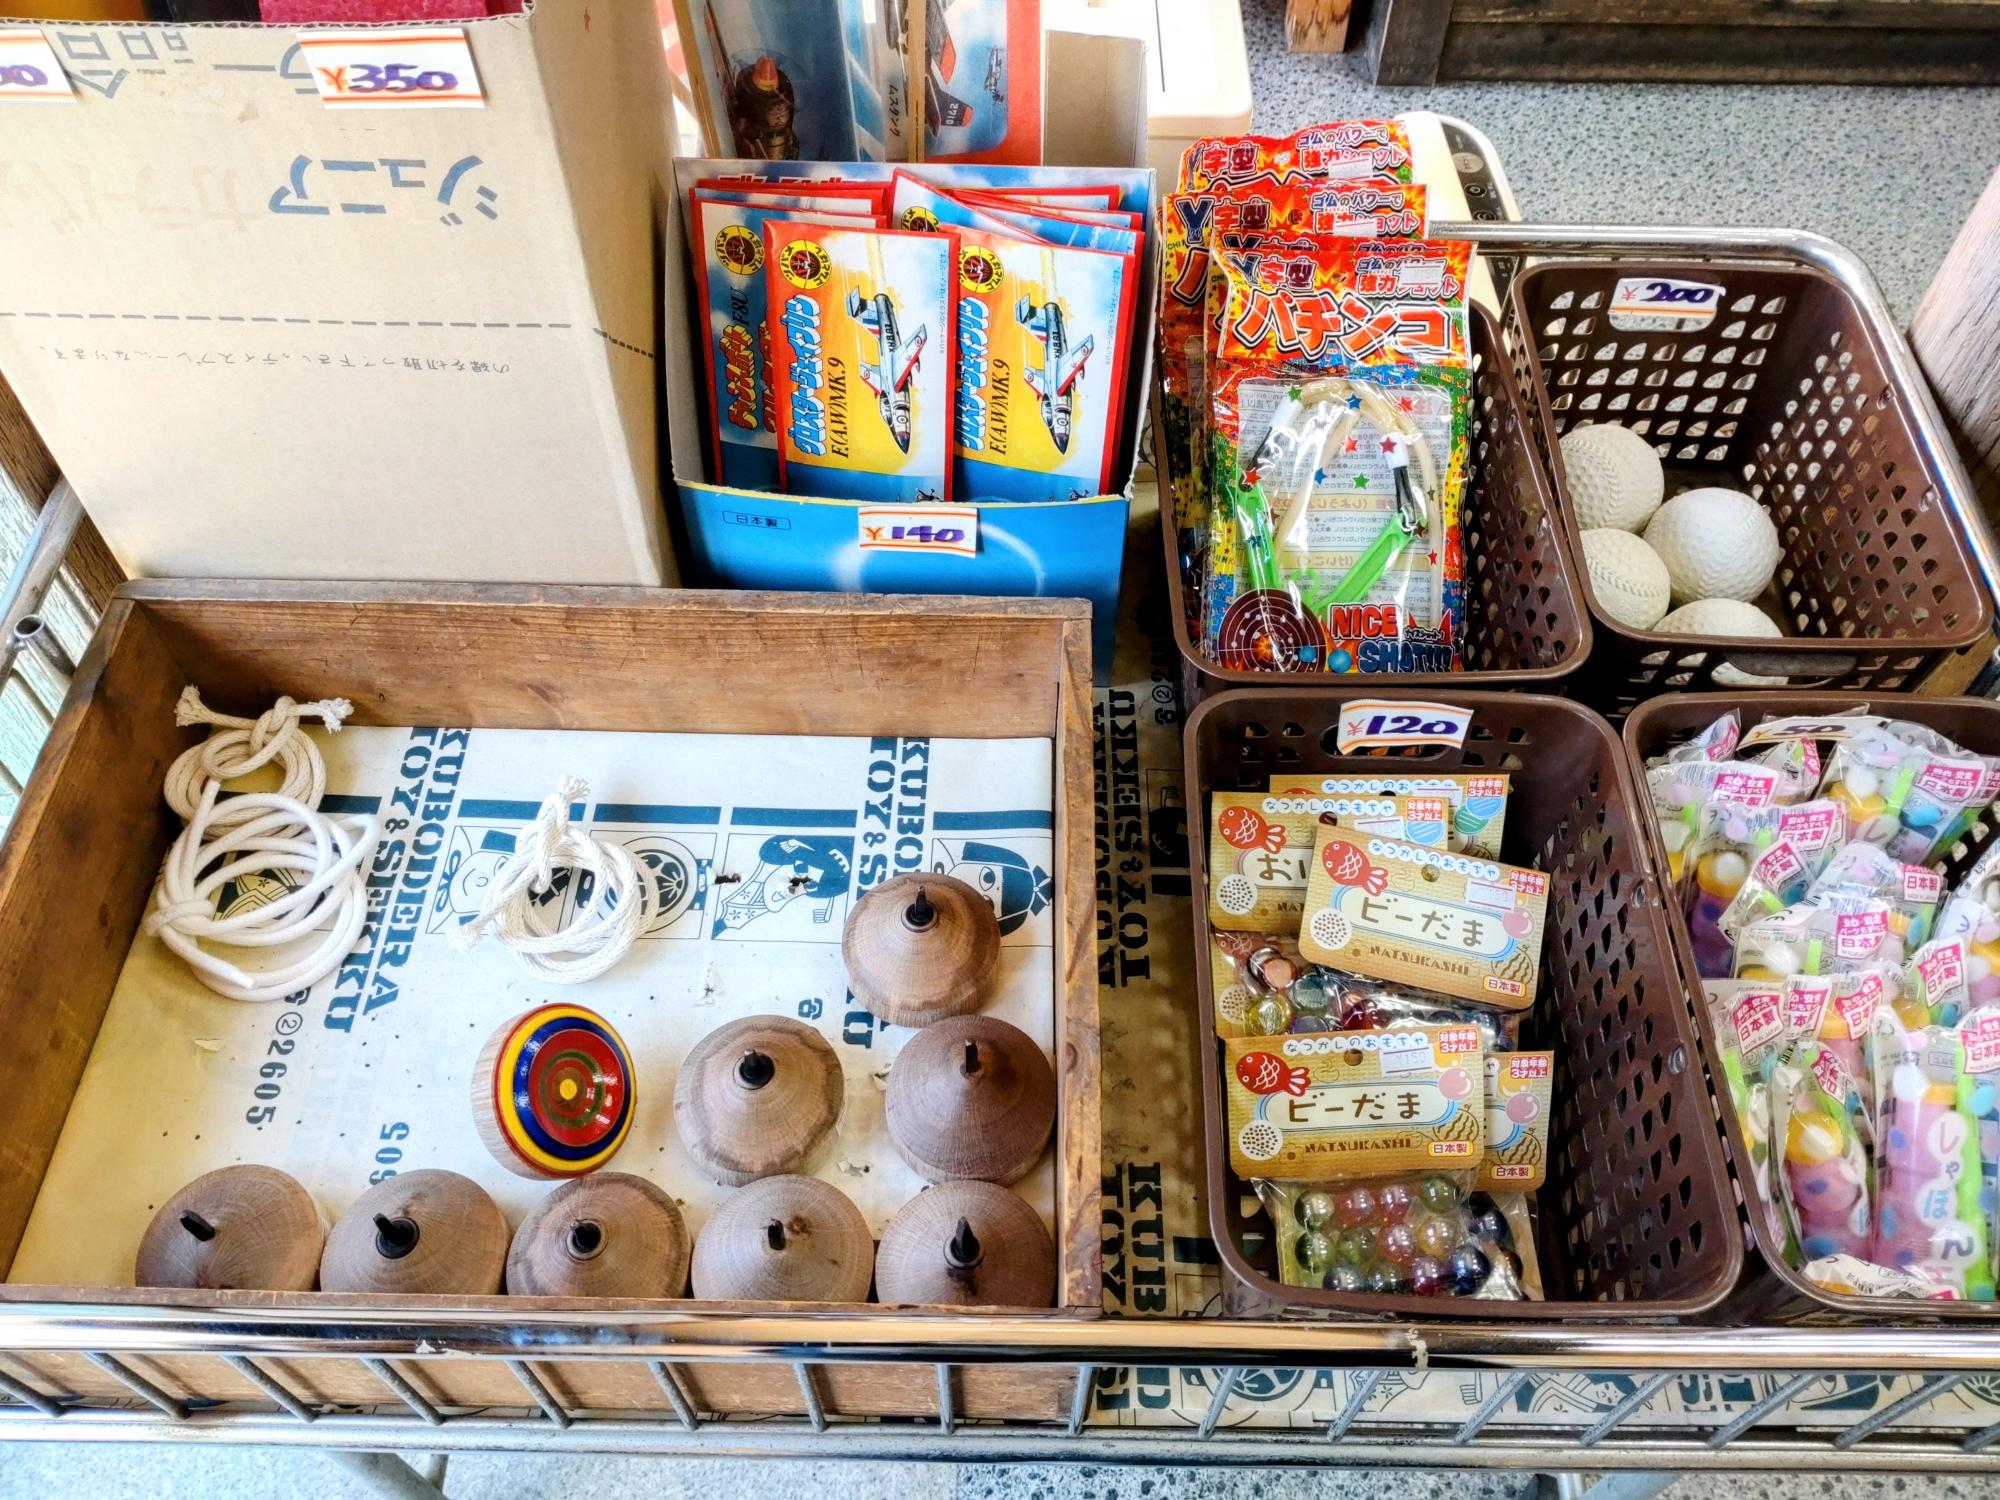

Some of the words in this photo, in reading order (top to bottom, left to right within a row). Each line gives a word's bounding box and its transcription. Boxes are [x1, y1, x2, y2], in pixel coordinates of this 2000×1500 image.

[318, 64, 458, 94] ¥350
[946, 102, 959, 126] 2710
[1299, 127, 1387, 145] ゴムのパワーで
[268, 154, 498, 227] ジュニア
[1312, 191, 1402, 208] ゴムのパワーで
[1176, 198, 1270, 243] Y字型
[1225, 254, 1315, 289] Y字型
[1621, 282, 1715, 304] ¥200
[729, 286, 751, 326] F8U
[1240, 289, 1449, 356] パチンコ
[736, 514, 778, 528] 日本製
[865, 525, 965, 543] ¥140
[1330, 606, 1400, 638] NICE
[1347, 715, 1459, 737] ¥120
[1467, 788, 1502, 797] 3才以上
[1468, 779, 1504, 789] 対象年齢
[893, 737, 931, 874] KUBO
[1265, 799, 1394, 814] なつかしのおもちゃ
[1407, 800, 1442, 811] 対象年齢
[1407, 812, 1442, 821] 3才以上
[1257, 853, 1306, 881] お
[1370, 842, 1499, 877] なつかしのおもちゃ
[363, 728, 472, 1016] KUBODERA
[1509, 871, 1545, 885] 対象年齢
[1907, 875, 1938, 891] 日本製
[1360, 896, 1485, 947] ビーだま
[1370, 945, 1470, 977] NATSUKASHI
[1487, 978, 1521, 994] 日本製
[1740, 1010, 1775, 1041] 日本製
[1286, 1036, 1425, 1052] なつかしのおもちゃ
[1439, 1031, 1477, 1042] 対象年齢
[1439, 1042, 1478, 1053] 3才以上
[1511, 1057, 1547, 1068] 対象年齢
[1511, 1067, 1548, 1079] 3才以上
[1288, 1092, 1421, 1123] ビーだま
[1304, 1138, 1412, 1154] NATSUKASHI
[1432, 1143, 1468, 1154] 日本製
[1495, 1166, 1530, 1177] 日本製
